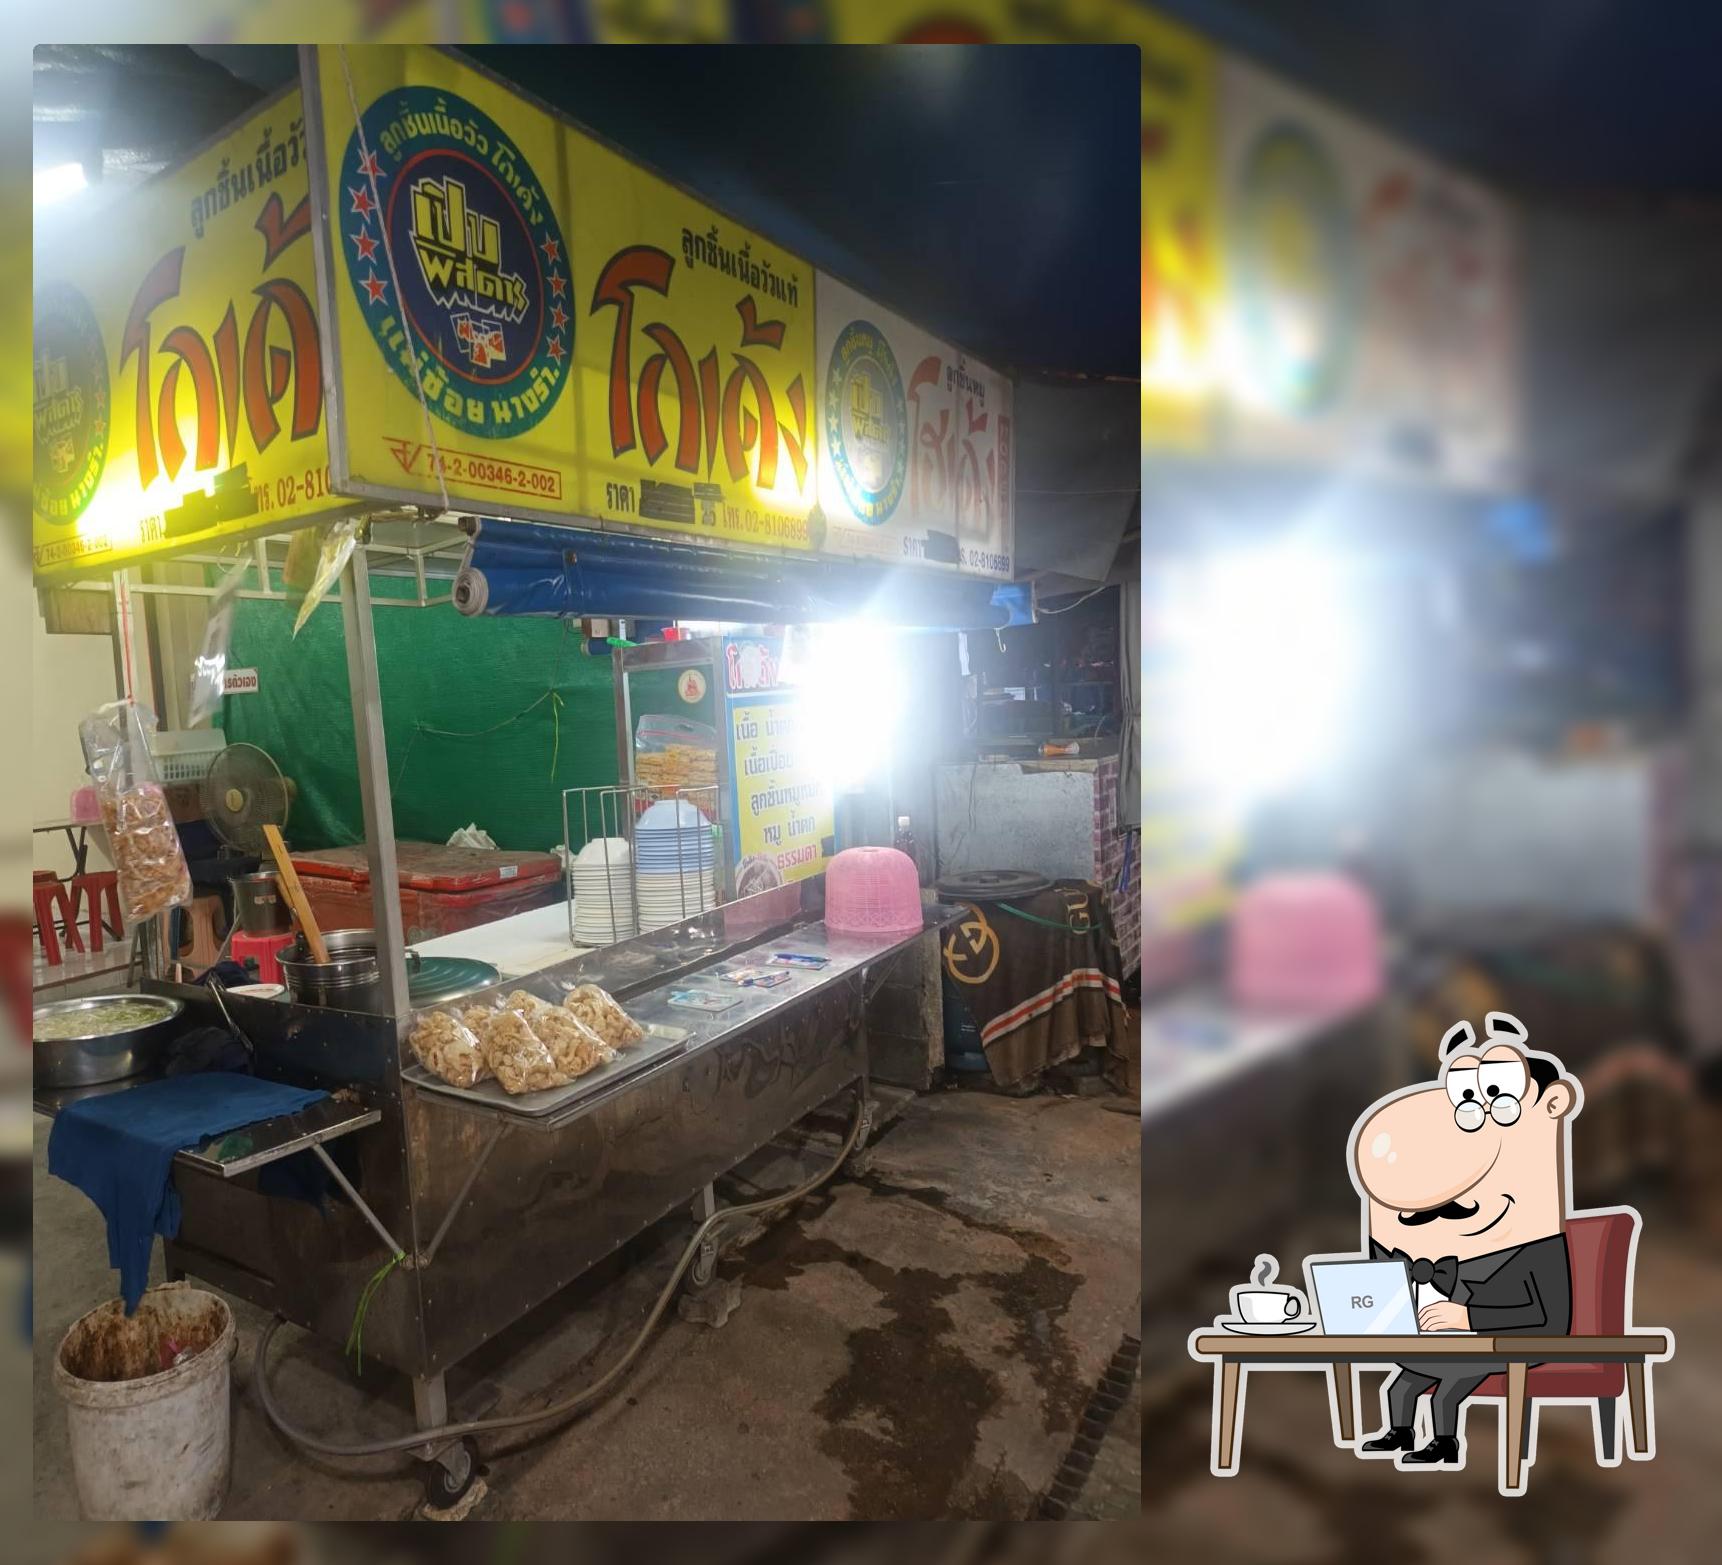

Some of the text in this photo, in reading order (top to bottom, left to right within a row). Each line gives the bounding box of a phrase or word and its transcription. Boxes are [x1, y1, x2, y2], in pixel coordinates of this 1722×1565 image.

[190, 117, 307, 240] ลูกชิ้นเนื้อวั
[682, 224, 799, 308] ลูกชิ้นเนื้อวัวแท้
[606, 482, 636, 513] ราคา
